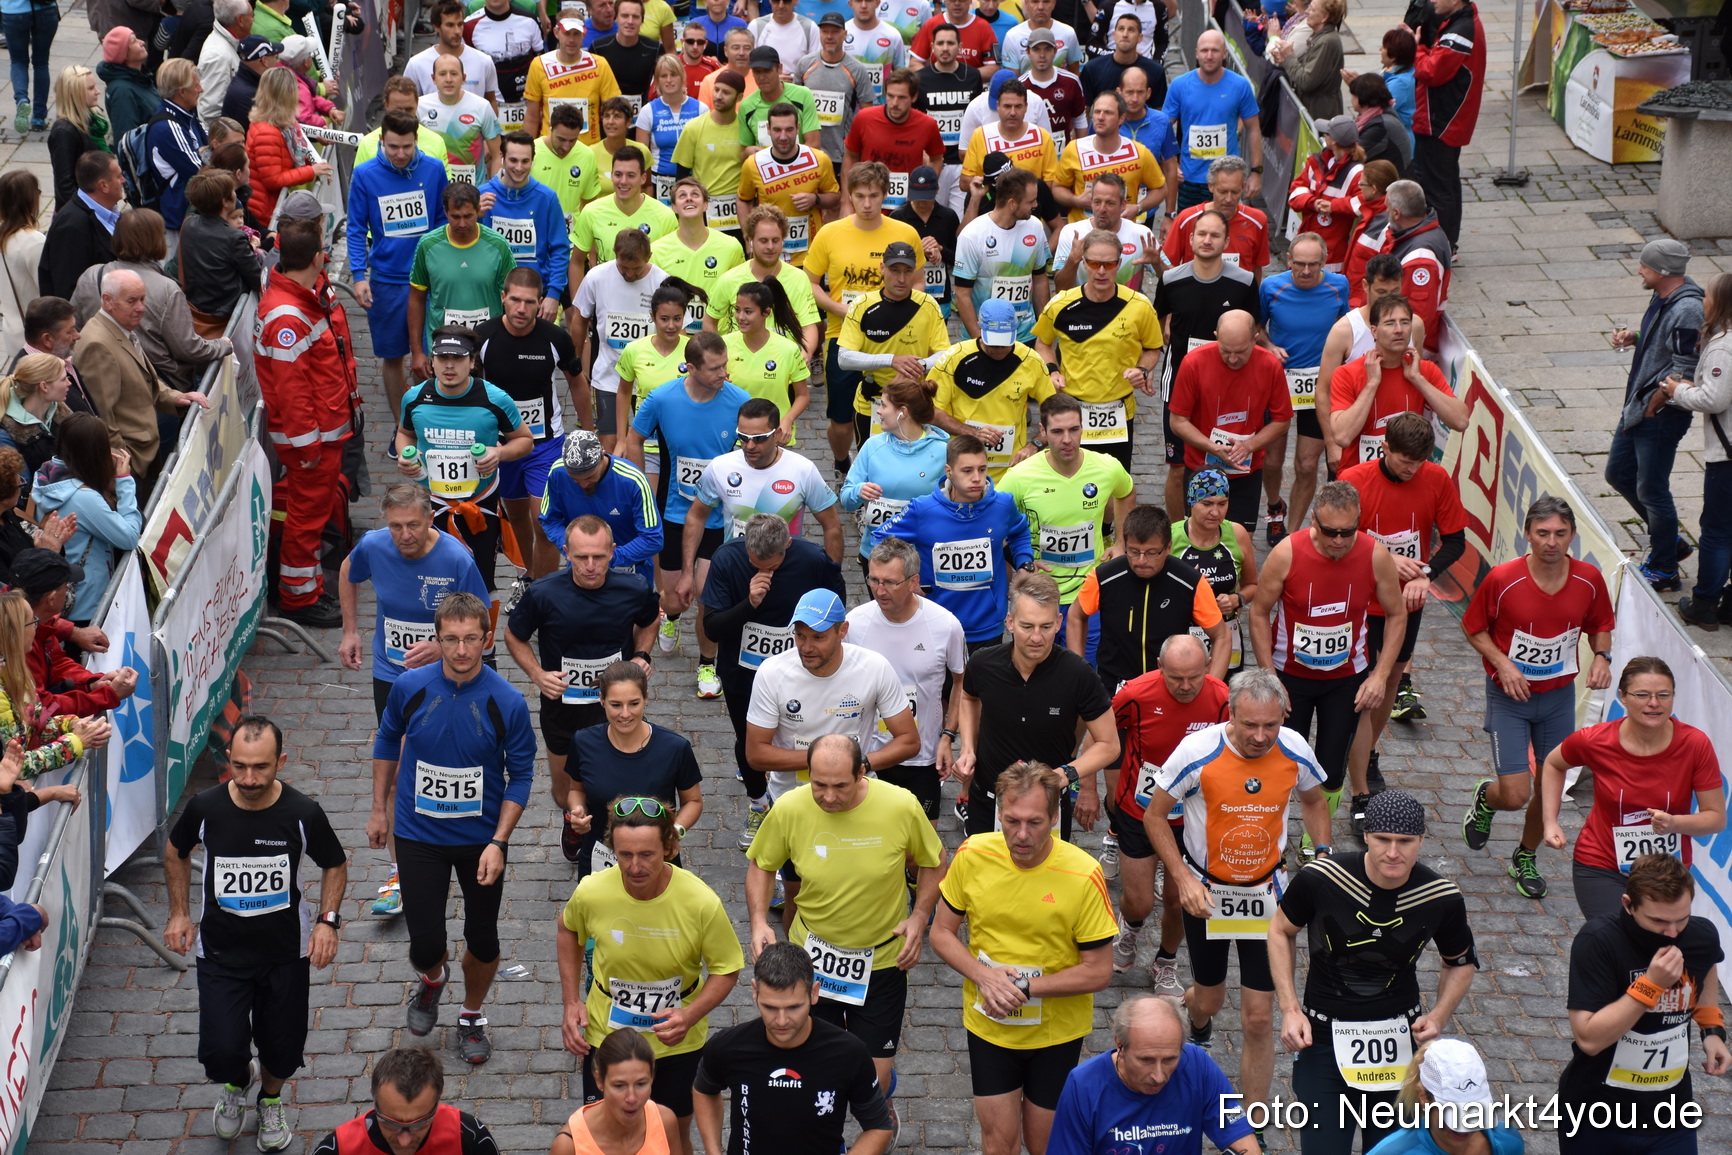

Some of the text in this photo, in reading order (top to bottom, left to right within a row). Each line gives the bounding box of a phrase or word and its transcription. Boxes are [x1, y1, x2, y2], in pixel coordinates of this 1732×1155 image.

[335, 24, 344, 50] BMW
[549, 71, 600, 91] MAX BÖGL
[926, 91, 971, 105] THULE
[816, 99, 837, 113] 278
[504, 109, 525, 122] 156
[938, 120, 961, 133] 219
[322, 131, 344, 143] BMW
[1196, 134, 1219, 148] 331
[1613, 126, 1665, 158] Lammsb
[1016, 149, 1043, 162] BÖGL
[1111, 163, 1141, 177] BÖGL
[569, 178, 581, 186] Partl
[765, 171, 822, 195] MAX BÖGL
[888, 181, 905, 196] 85
[396, 195, 418, 203] Neumarkt
[385, 201, 423, 221] 2108
[714, 202, 738, 217] 100
[397, 221, 417, 231] Tobias
[789, 225, 806, 239] 67
[997, 285, 1029, 303] 2126
[446, 312, 462, 320] PARTL
[611, 321, 650, 340] 2301
[866, 329, 890, 337] Steffen
[1068, 324, 1093, 332] Markus
[522, 353, 547, 361] PFLEIDERER
[966, 376, 986, 387] Peter
[1295, 378, 1319, 395] 36
[1298, 396, 1315, 405] Oswa
[520, 409, 541, 425] 22
[1088, 411, 1117, 428] 525
[424, 427, 476, 441] HUBER
[1212, 431, 1230, 441] PARTL
[678, 459, 695, 468] PARTL
[437, 461, 470, 480] 181
[445, 483, 462, 493] Sven
[774, 481, 794, 491] Hervis
[870, 500, 887, 509] PARTL
[1082, 499, 1099, 508] Partl
[1041, 527, 1088, 536] PARTL Neumarkt
[934, 544, 981, 553] PARTL Neumarkt
[1045, 533, 1090, 553] 2671
[1386, 538, 1413, 546] Neumarkt
[938, 551, 987, 571] 2023
[1060, 555, 1077, 564] Ralf
[950, 574, 977, 583] Pascal
[1199, 567, 1218, 577] DAV
[1320, 606, 1337, 614] DEHN
[386, 621, 435, 633] PARTL Neumarkt
[744, 624, 792, 638] PARTL Neumarkt
[1296, 626, 1344, 637] PARTL Neumarkt
[746, 633, 795, 656] 2680
[1300, 635, 1348, 655] 2199
[1514, 633, 1562, 648] PARTL Neumarkt
[1515, 643, 1562, 665] 2231
[562, 661, 613, 669] PARTL Neumarkt
[1312, 657, 1334, 668] Peter
[1521, 664, 1553, 675] Thomas
[568, 669, 606, 687] 265
[582, 690, 601, 698] Klau
[417, 766, 472, 779] PARTL Neumarkt
[421, 775, 479, 800] 2515
[436, 802, 460, 812] Maik
[1220, 803, 1281, 814] SportScheck
[1614, 831, 1640, 840] PARTL
[594, 847, 613, 861] PARTL
[1234, 848, 1268, 857] Stadtlauf
[1623, 834, 1678, 862] 2039
[216, 861, 278, 870] PARTL Neumarkt
[1219, 852, 1267, 866] Nürnberg
[222, 870, 285, 894] 2026
[1207, 888, 1266, 899] PARTL Neumarkt
[239, 898, 268, 910] Eyuep
[1220, 897, 1265, 918] 540
[807, 933, 863, 960] PARTL Neumarkt
[811, 945, 867, 982] 2089
[610, 980, 673, 991] PARTL Neumarkt
[814, 976, 848, 994] Markus
[616, 989, 678, 1014] 2472
[631, 1015, 660, 1026] Claus
[1335, 1027, 1398, 1038] PARTL Neumarkt
[1620, 1033, 1681, 1048] PARTL Neumarkt
[1351, 1037, 1398, 1065] 209
[1642, 1046, 1670, 1070] 71
[1356, 1071, 1396, 1082] Andreas
[1630, 1073, 1670, 1084] Thomas
[768, 1078, 802, 1089] skinfit
[1114, 1126, 1148, 1141] hella
[1146, 1123, 1179, 1132] hamburg
